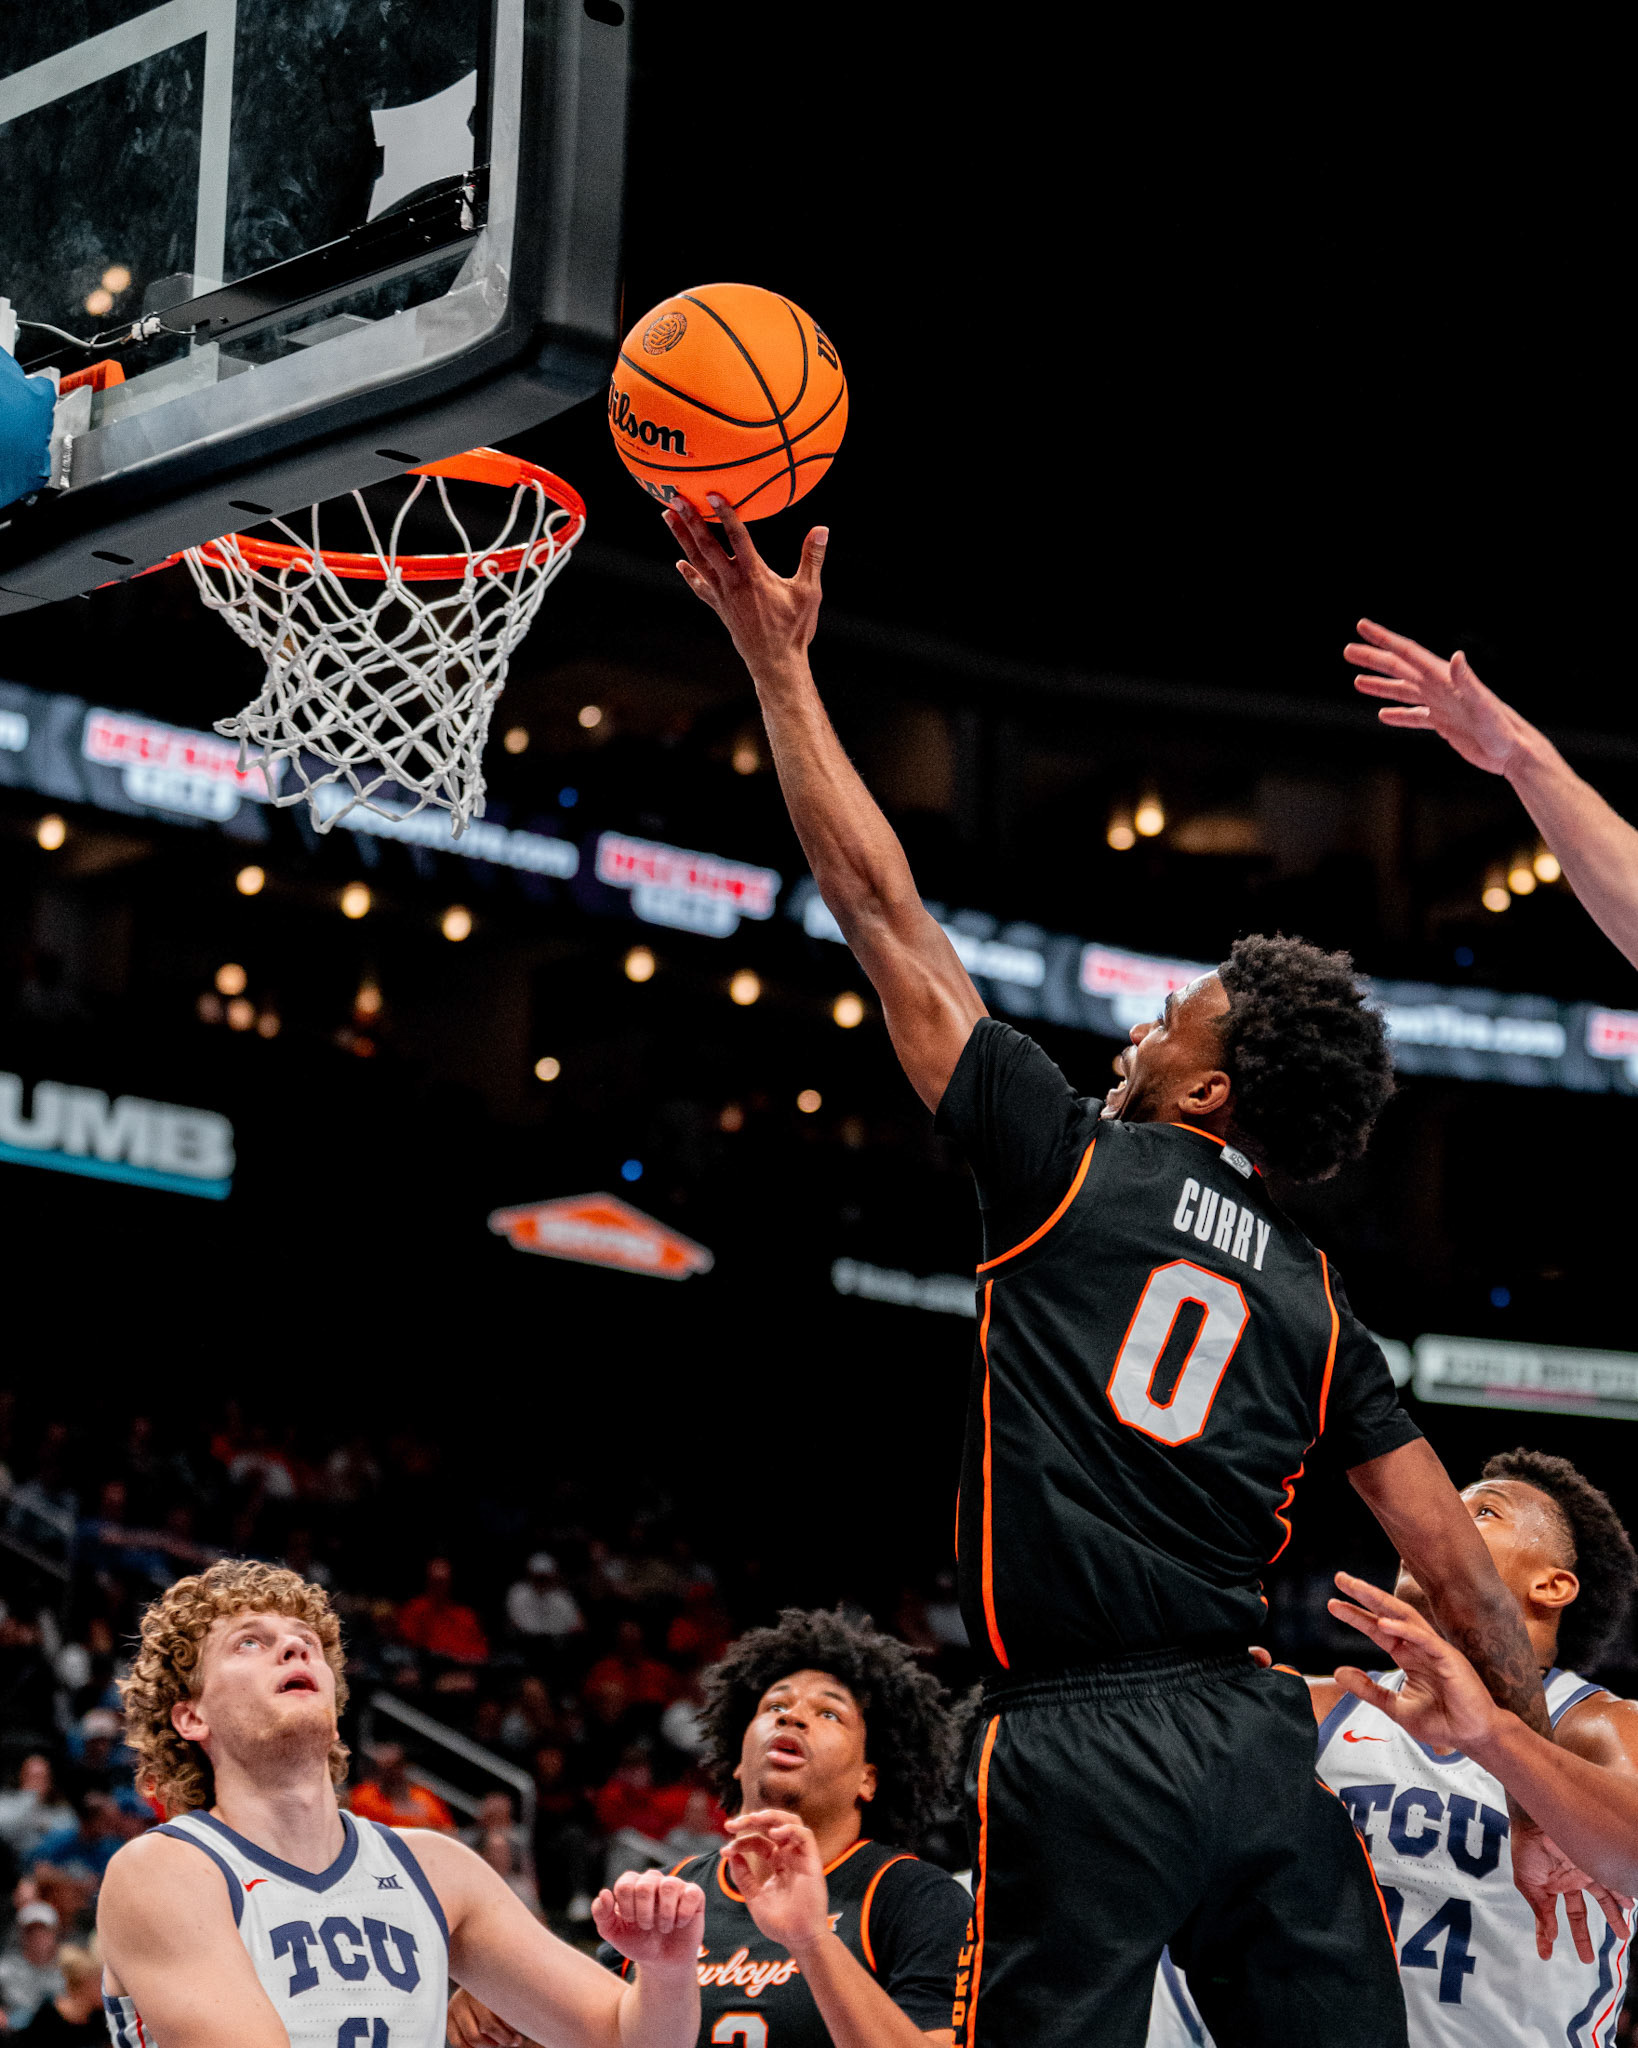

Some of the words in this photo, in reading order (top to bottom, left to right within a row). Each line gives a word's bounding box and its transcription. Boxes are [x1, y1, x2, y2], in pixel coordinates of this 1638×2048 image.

[0, 1071, 236, 1181] UMB
[1173, 1177, 1271, 1271] CURRY
[1105, 1258, 1250, 1447] 0
[1340, 1784, 1510, 1880] TCU
[269, 1916, 421, 1998] TCU
[697, 1944, 800, 1998] wboys
[1378, 1885, 1476, 2005] 4
